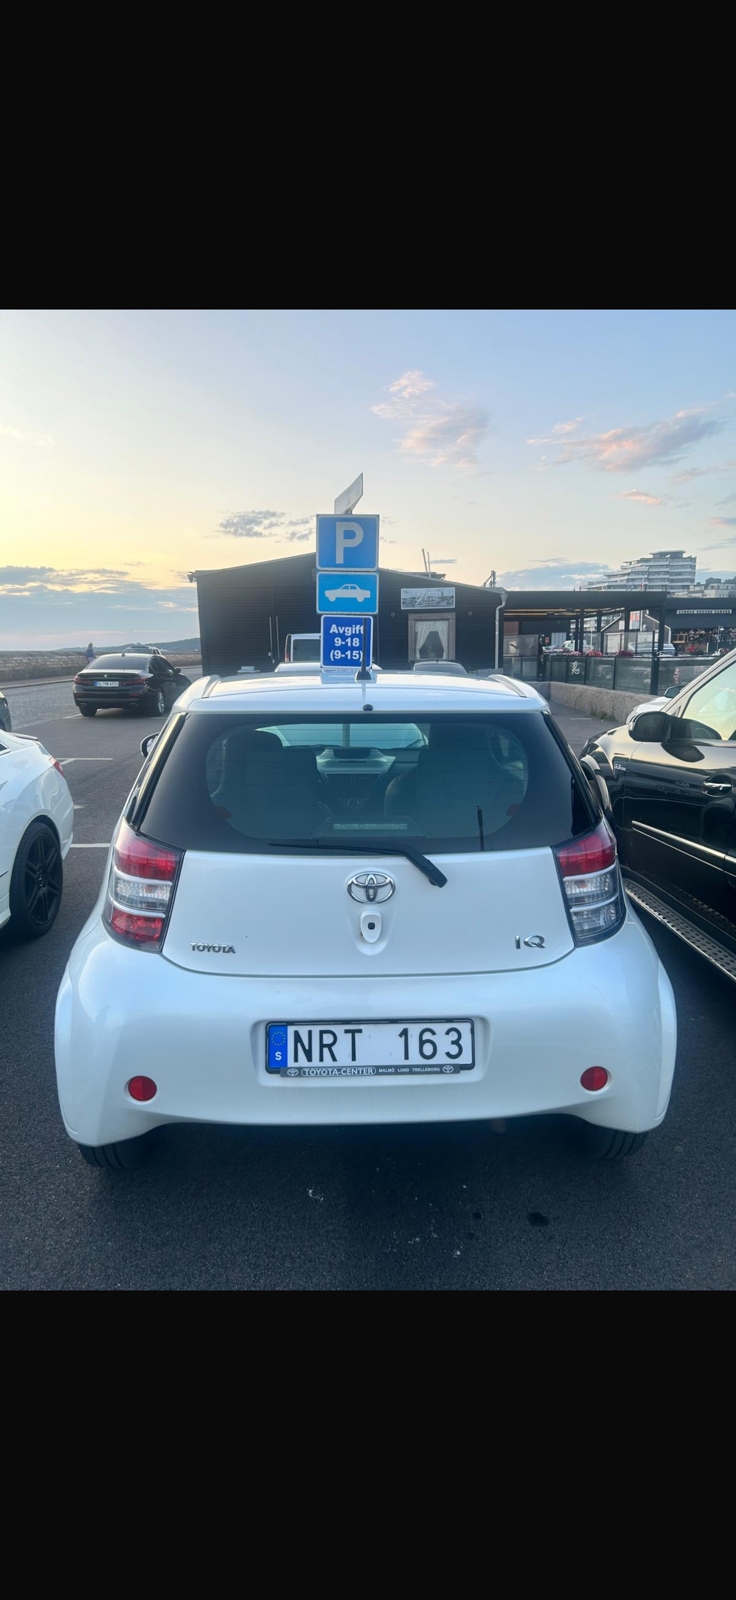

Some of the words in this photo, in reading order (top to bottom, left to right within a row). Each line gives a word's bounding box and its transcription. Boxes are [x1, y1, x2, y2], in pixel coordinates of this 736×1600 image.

[335, 521, 364, 564] P
[329, 624, 364, 636] Avgift
[334, 637, 360, 647] 9-18
[330, 650, 363, 662] (9-15)
[190, 942, 236, 954] TOYOTA
[293, 1028, 363, 1063] NRT
[398, 1027, 463, 1061] 163
[275, 1051, 282, 1061] S
[304, 1067, 374, 1076] TOYOTA-CENTER
